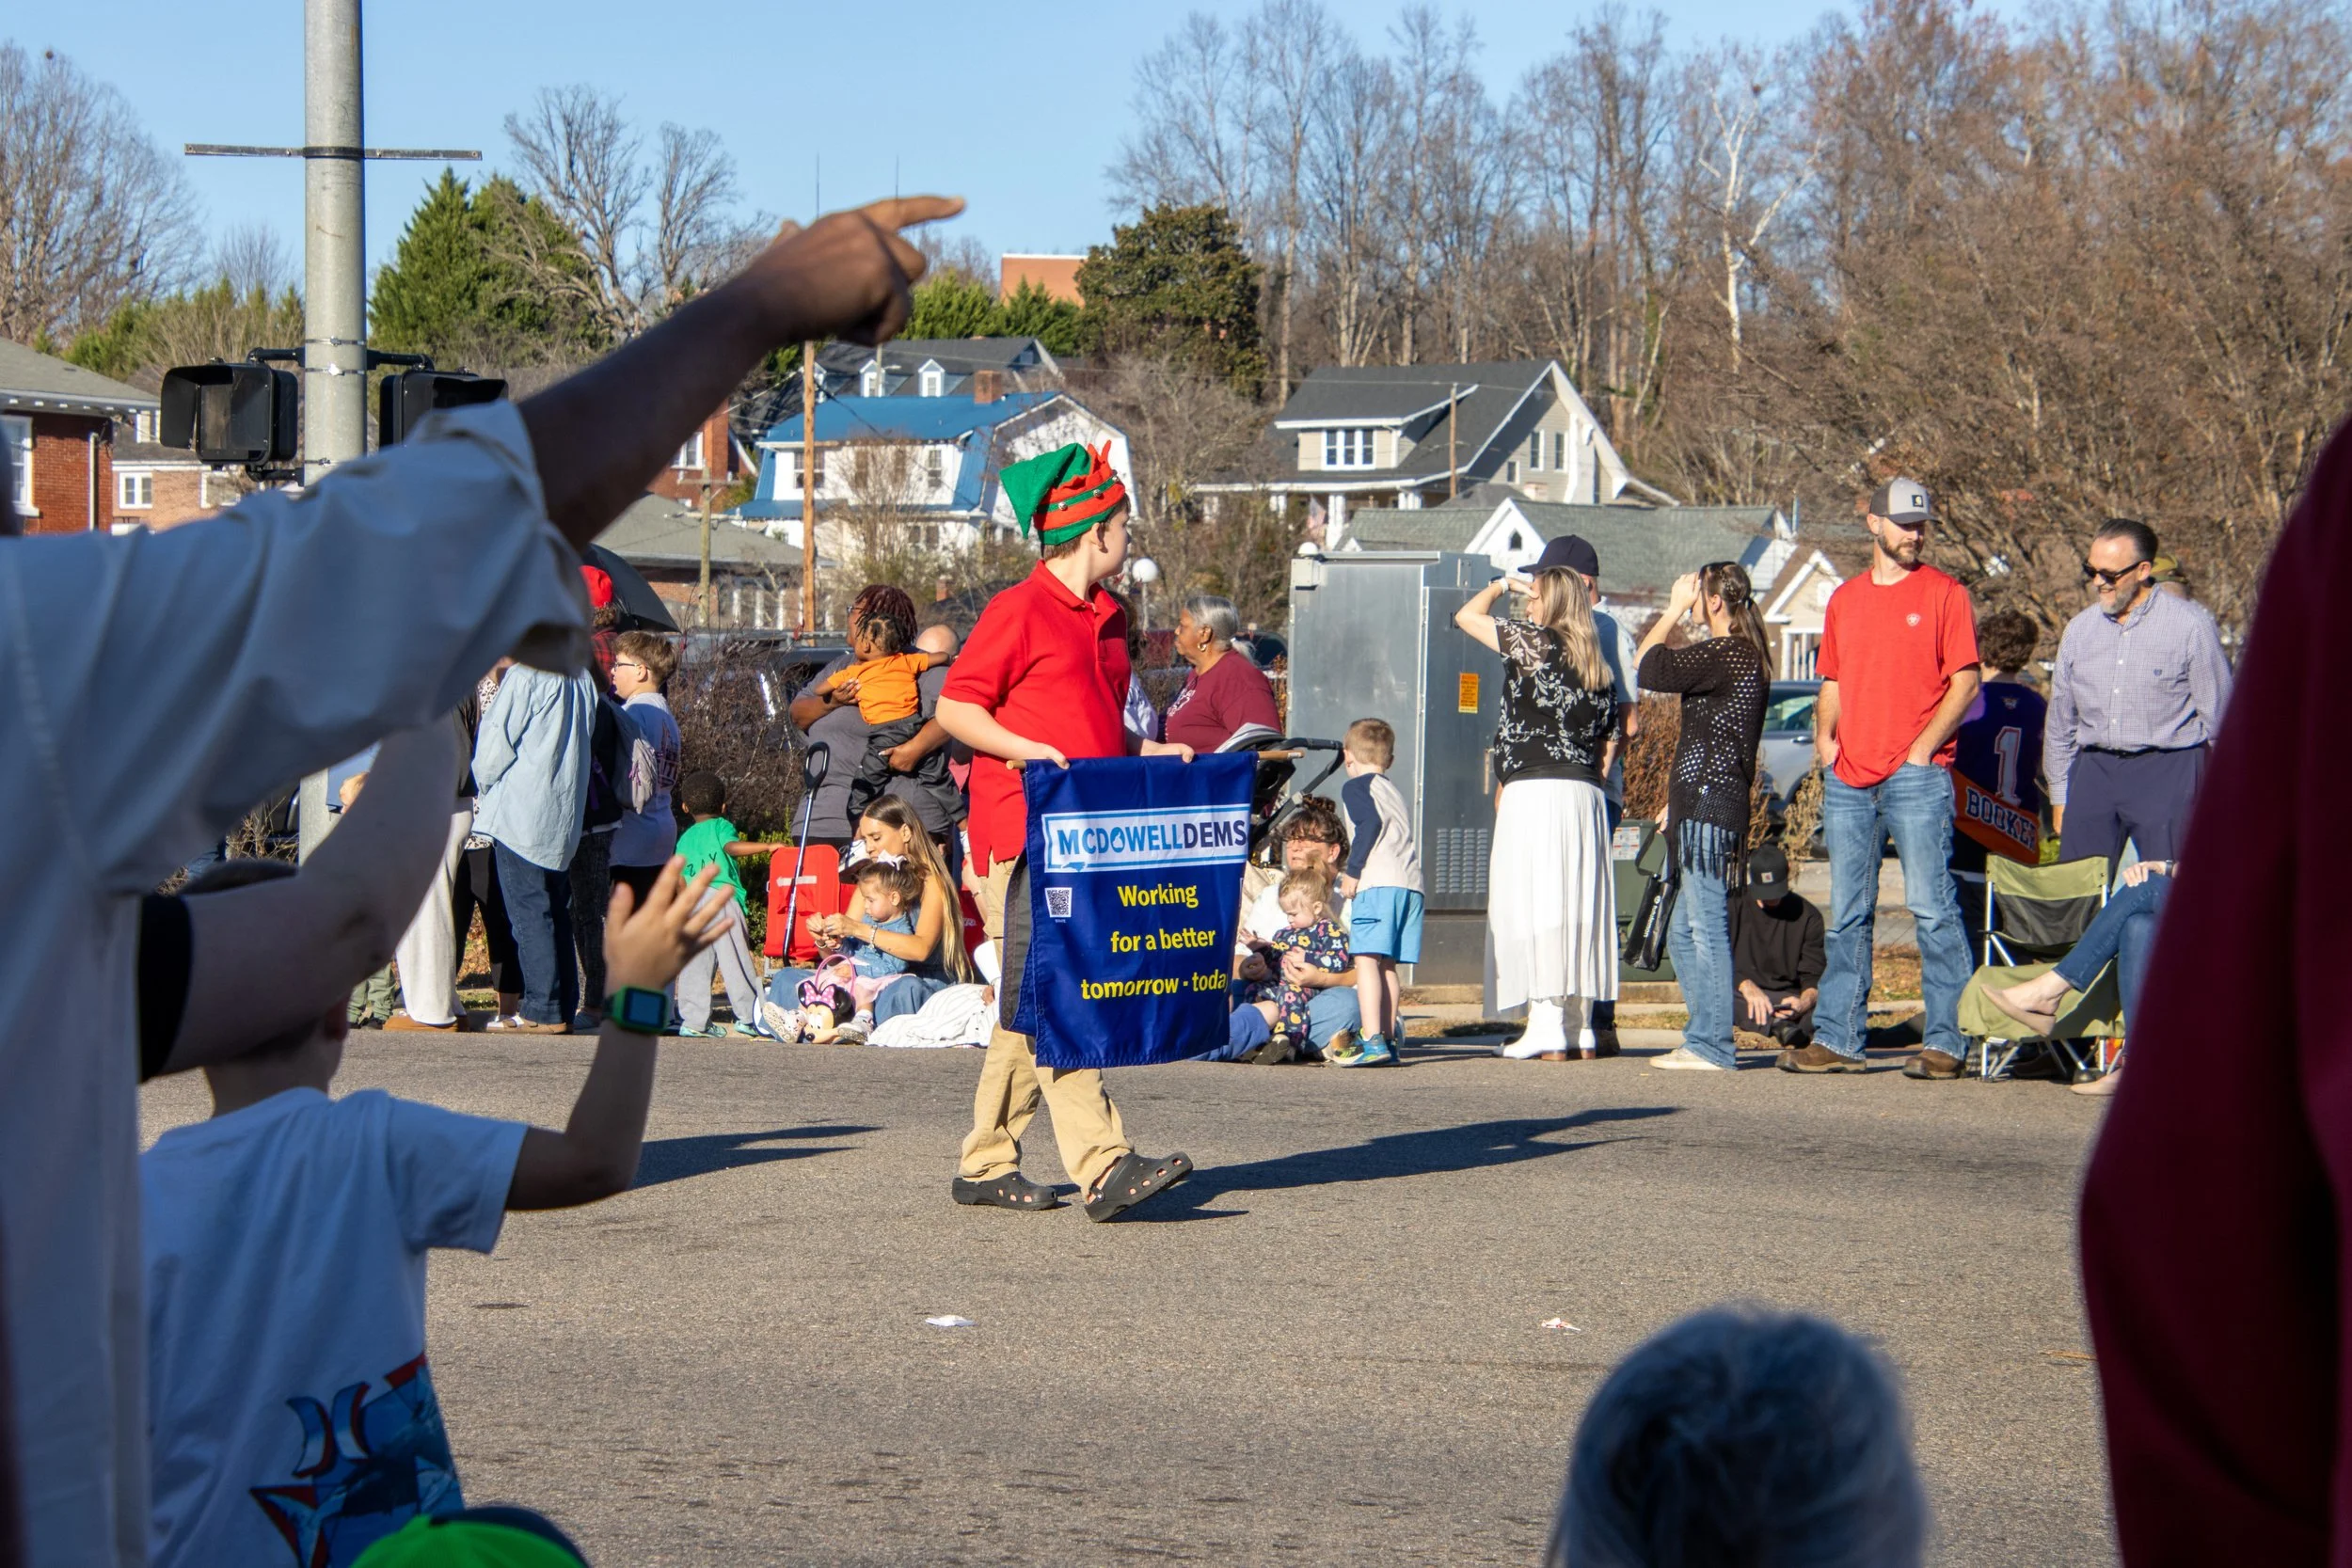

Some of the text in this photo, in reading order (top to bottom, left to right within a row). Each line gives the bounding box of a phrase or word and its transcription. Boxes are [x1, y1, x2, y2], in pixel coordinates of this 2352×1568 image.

[1994, 725, 2022, 806] 1
[1118, 883, 1199, 908] Working
[1110, 928, 1216, 952] for a better
[1080, 978, 1178, 1000] tomorrow
[1191, 969, 1228, 993] toda
